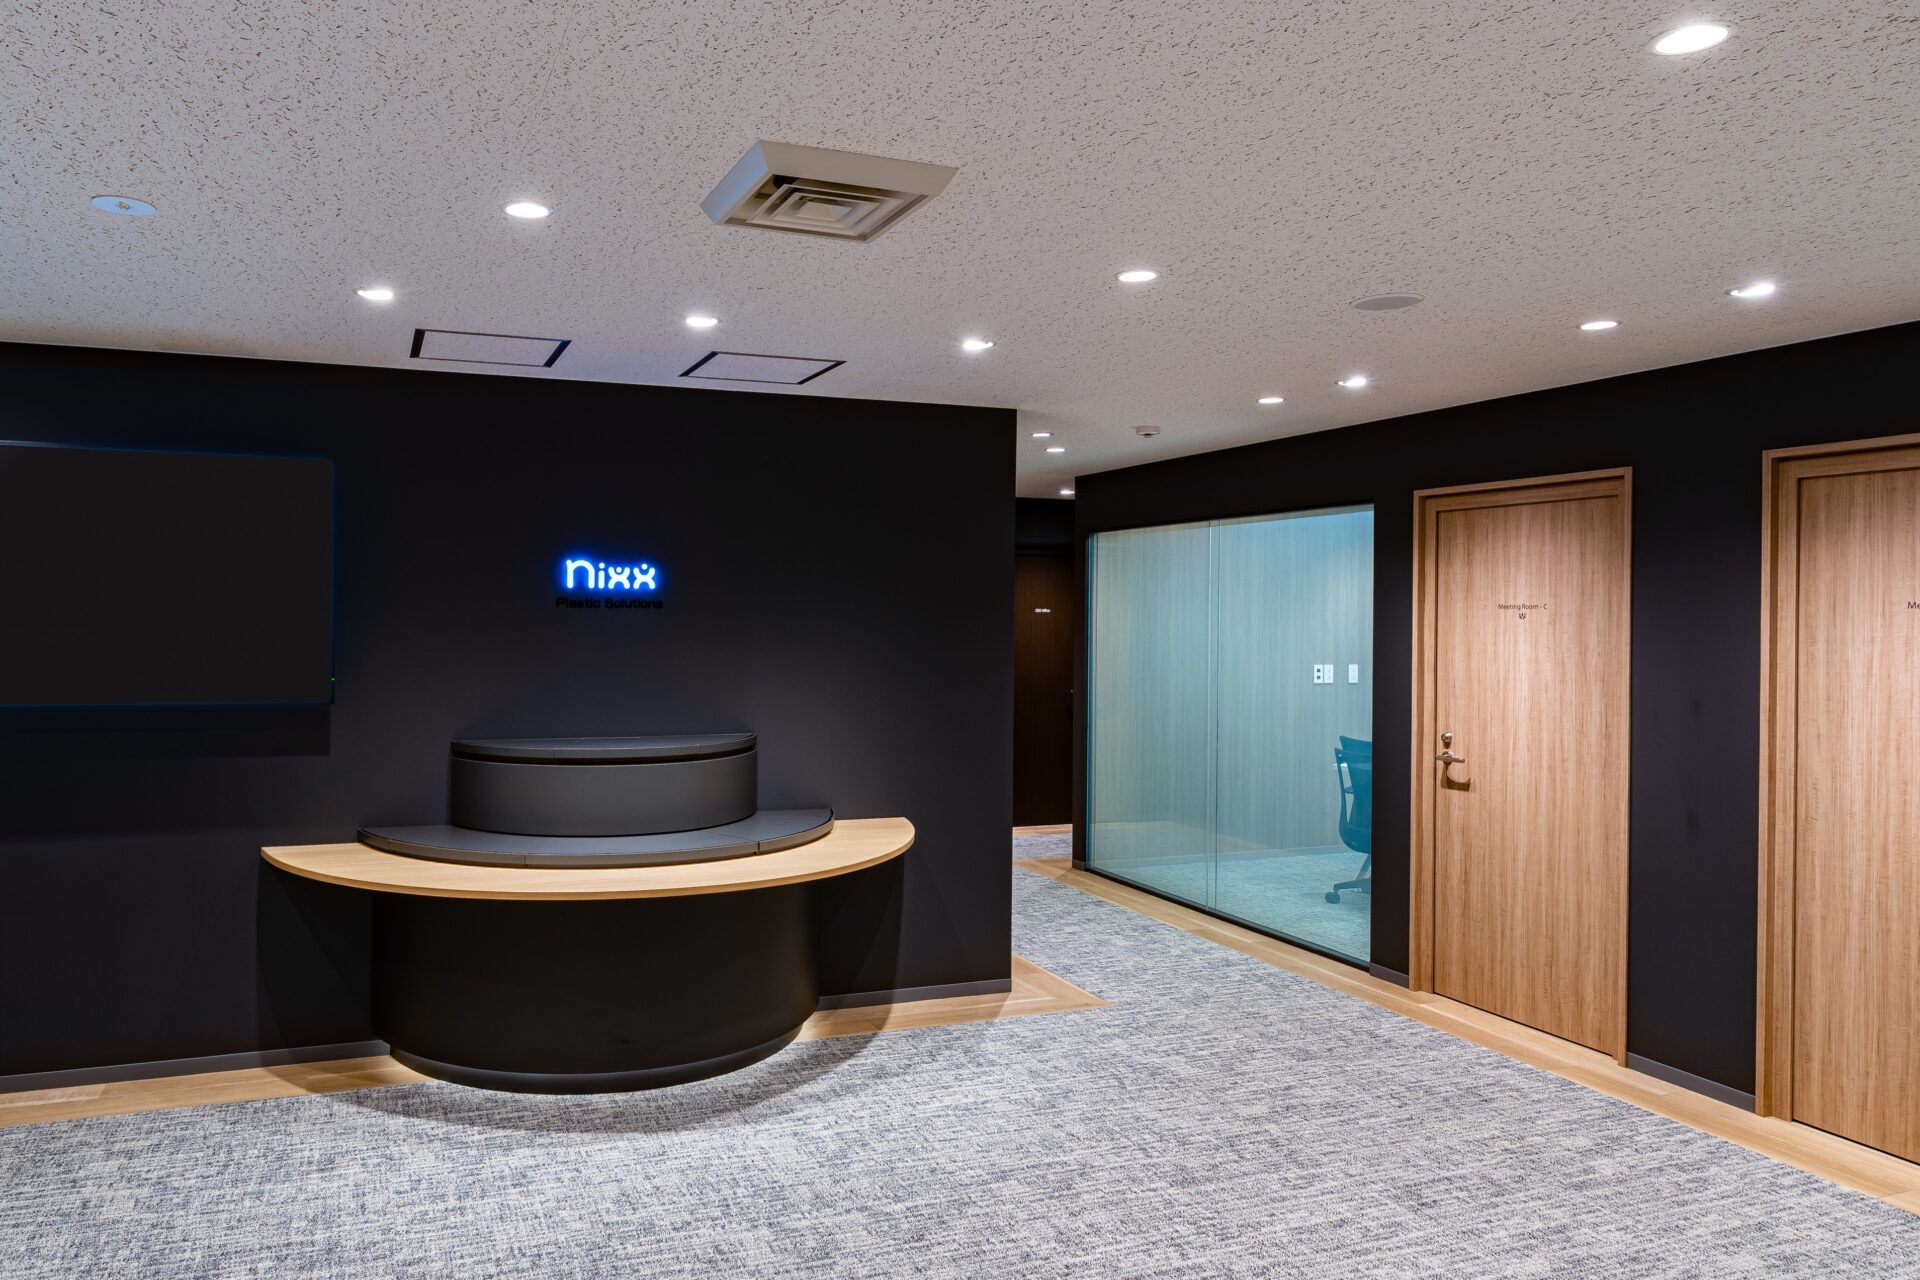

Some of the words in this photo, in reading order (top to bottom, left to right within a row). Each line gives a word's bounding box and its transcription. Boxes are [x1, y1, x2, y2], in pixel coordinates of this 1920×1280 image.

[555, 597, 601, 609] Plastic
[605, 597, 663, 609] Solutions
[1498, 603, 1520, 611] Meeting
